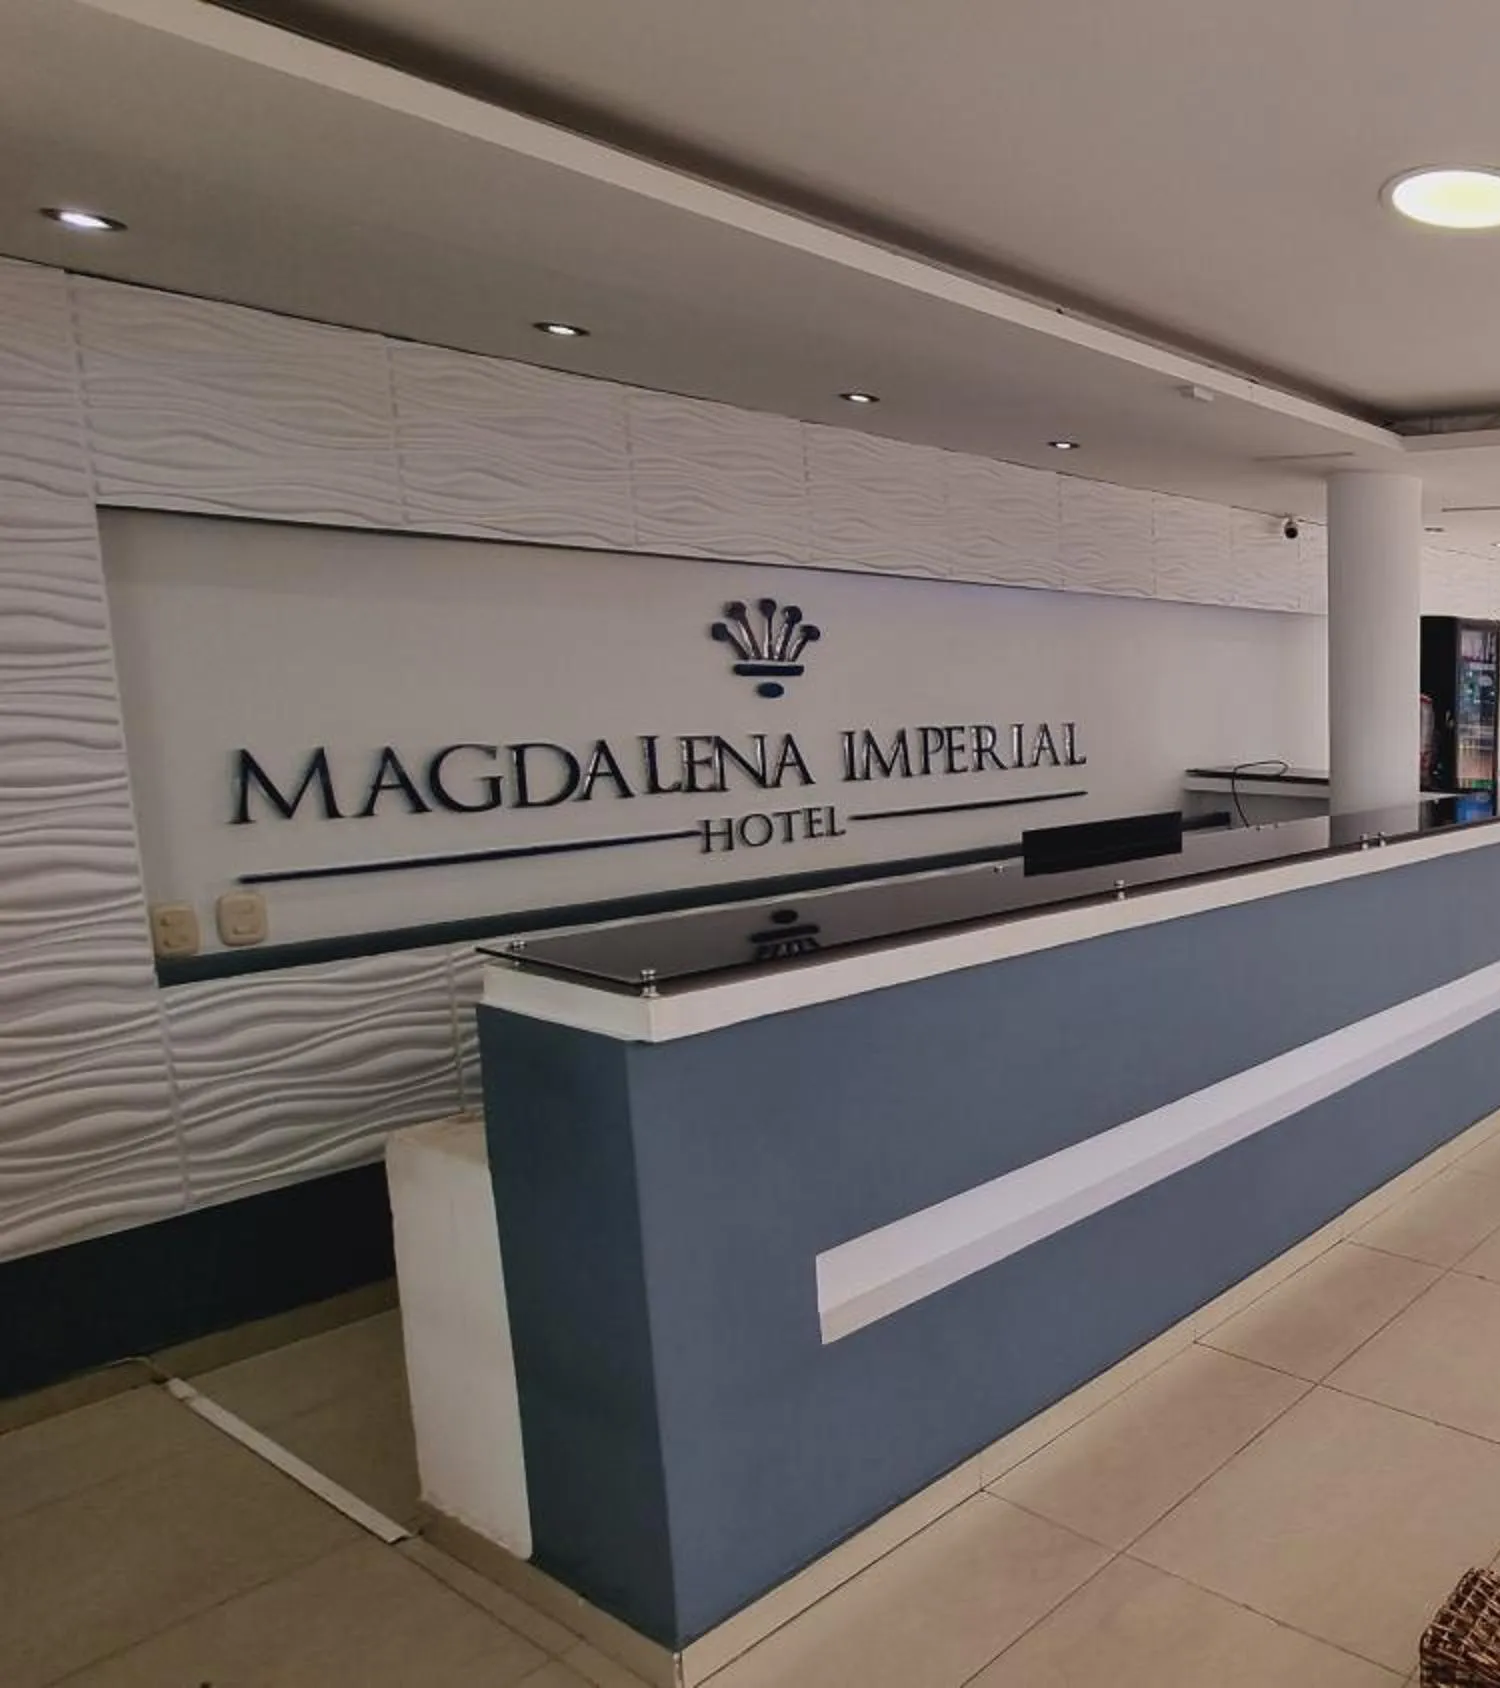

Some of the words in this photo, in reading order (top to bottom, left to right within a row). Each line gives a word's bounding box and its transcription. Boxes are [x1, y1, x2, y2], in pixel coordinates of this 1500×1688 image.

[229, 733, 817, 825] MAGDALENA
[840, 722, 1087, 781] IMPERIAL
[701, 805, 846, 854] HOTEL
